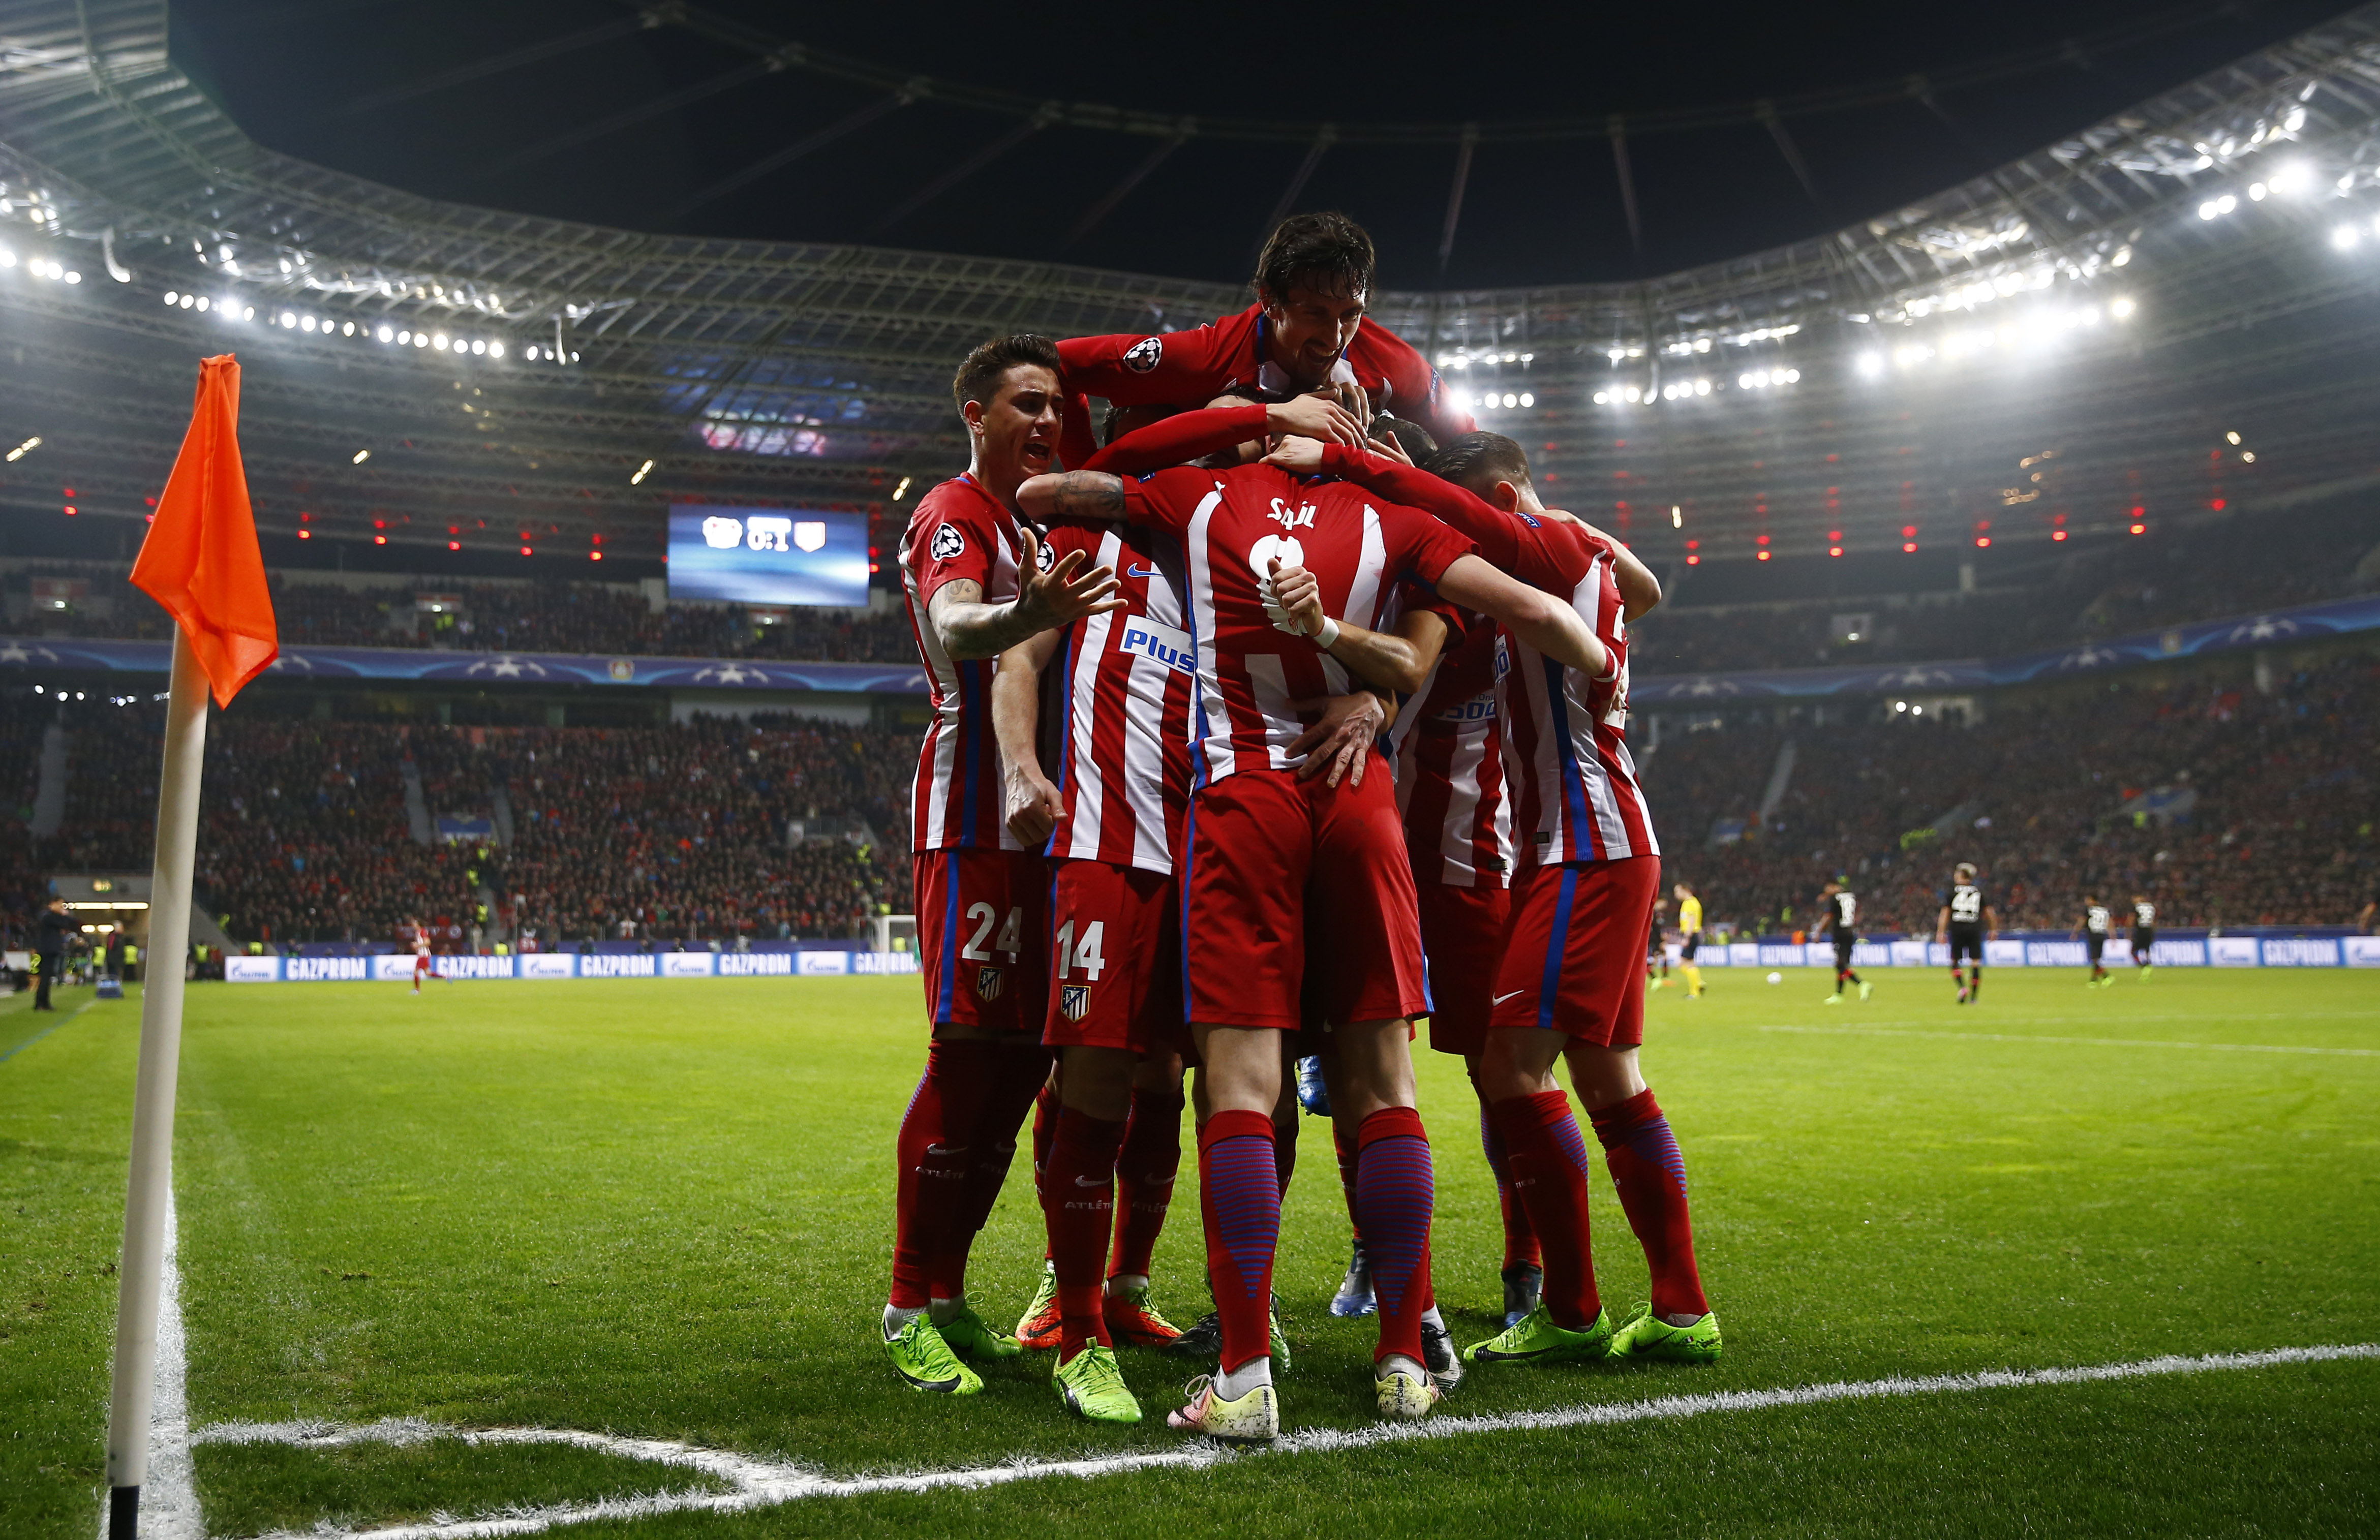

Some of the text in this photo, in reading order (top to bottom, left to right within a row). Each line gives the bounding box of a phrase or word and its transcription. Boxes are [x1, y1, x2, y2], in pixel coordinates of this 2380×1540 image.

[1124, 629, 1195, 673] Plus
[962, 901, 1022, 964] 24
[1056, 919, 1105, 981] 14
[286, 957, 367, 980] GAZPROM
[436, 955, 513, 978] GAZPROM
[581, 954, 655, 977] GAZPROM
[719, 953, 791, 975] GAZPROM
